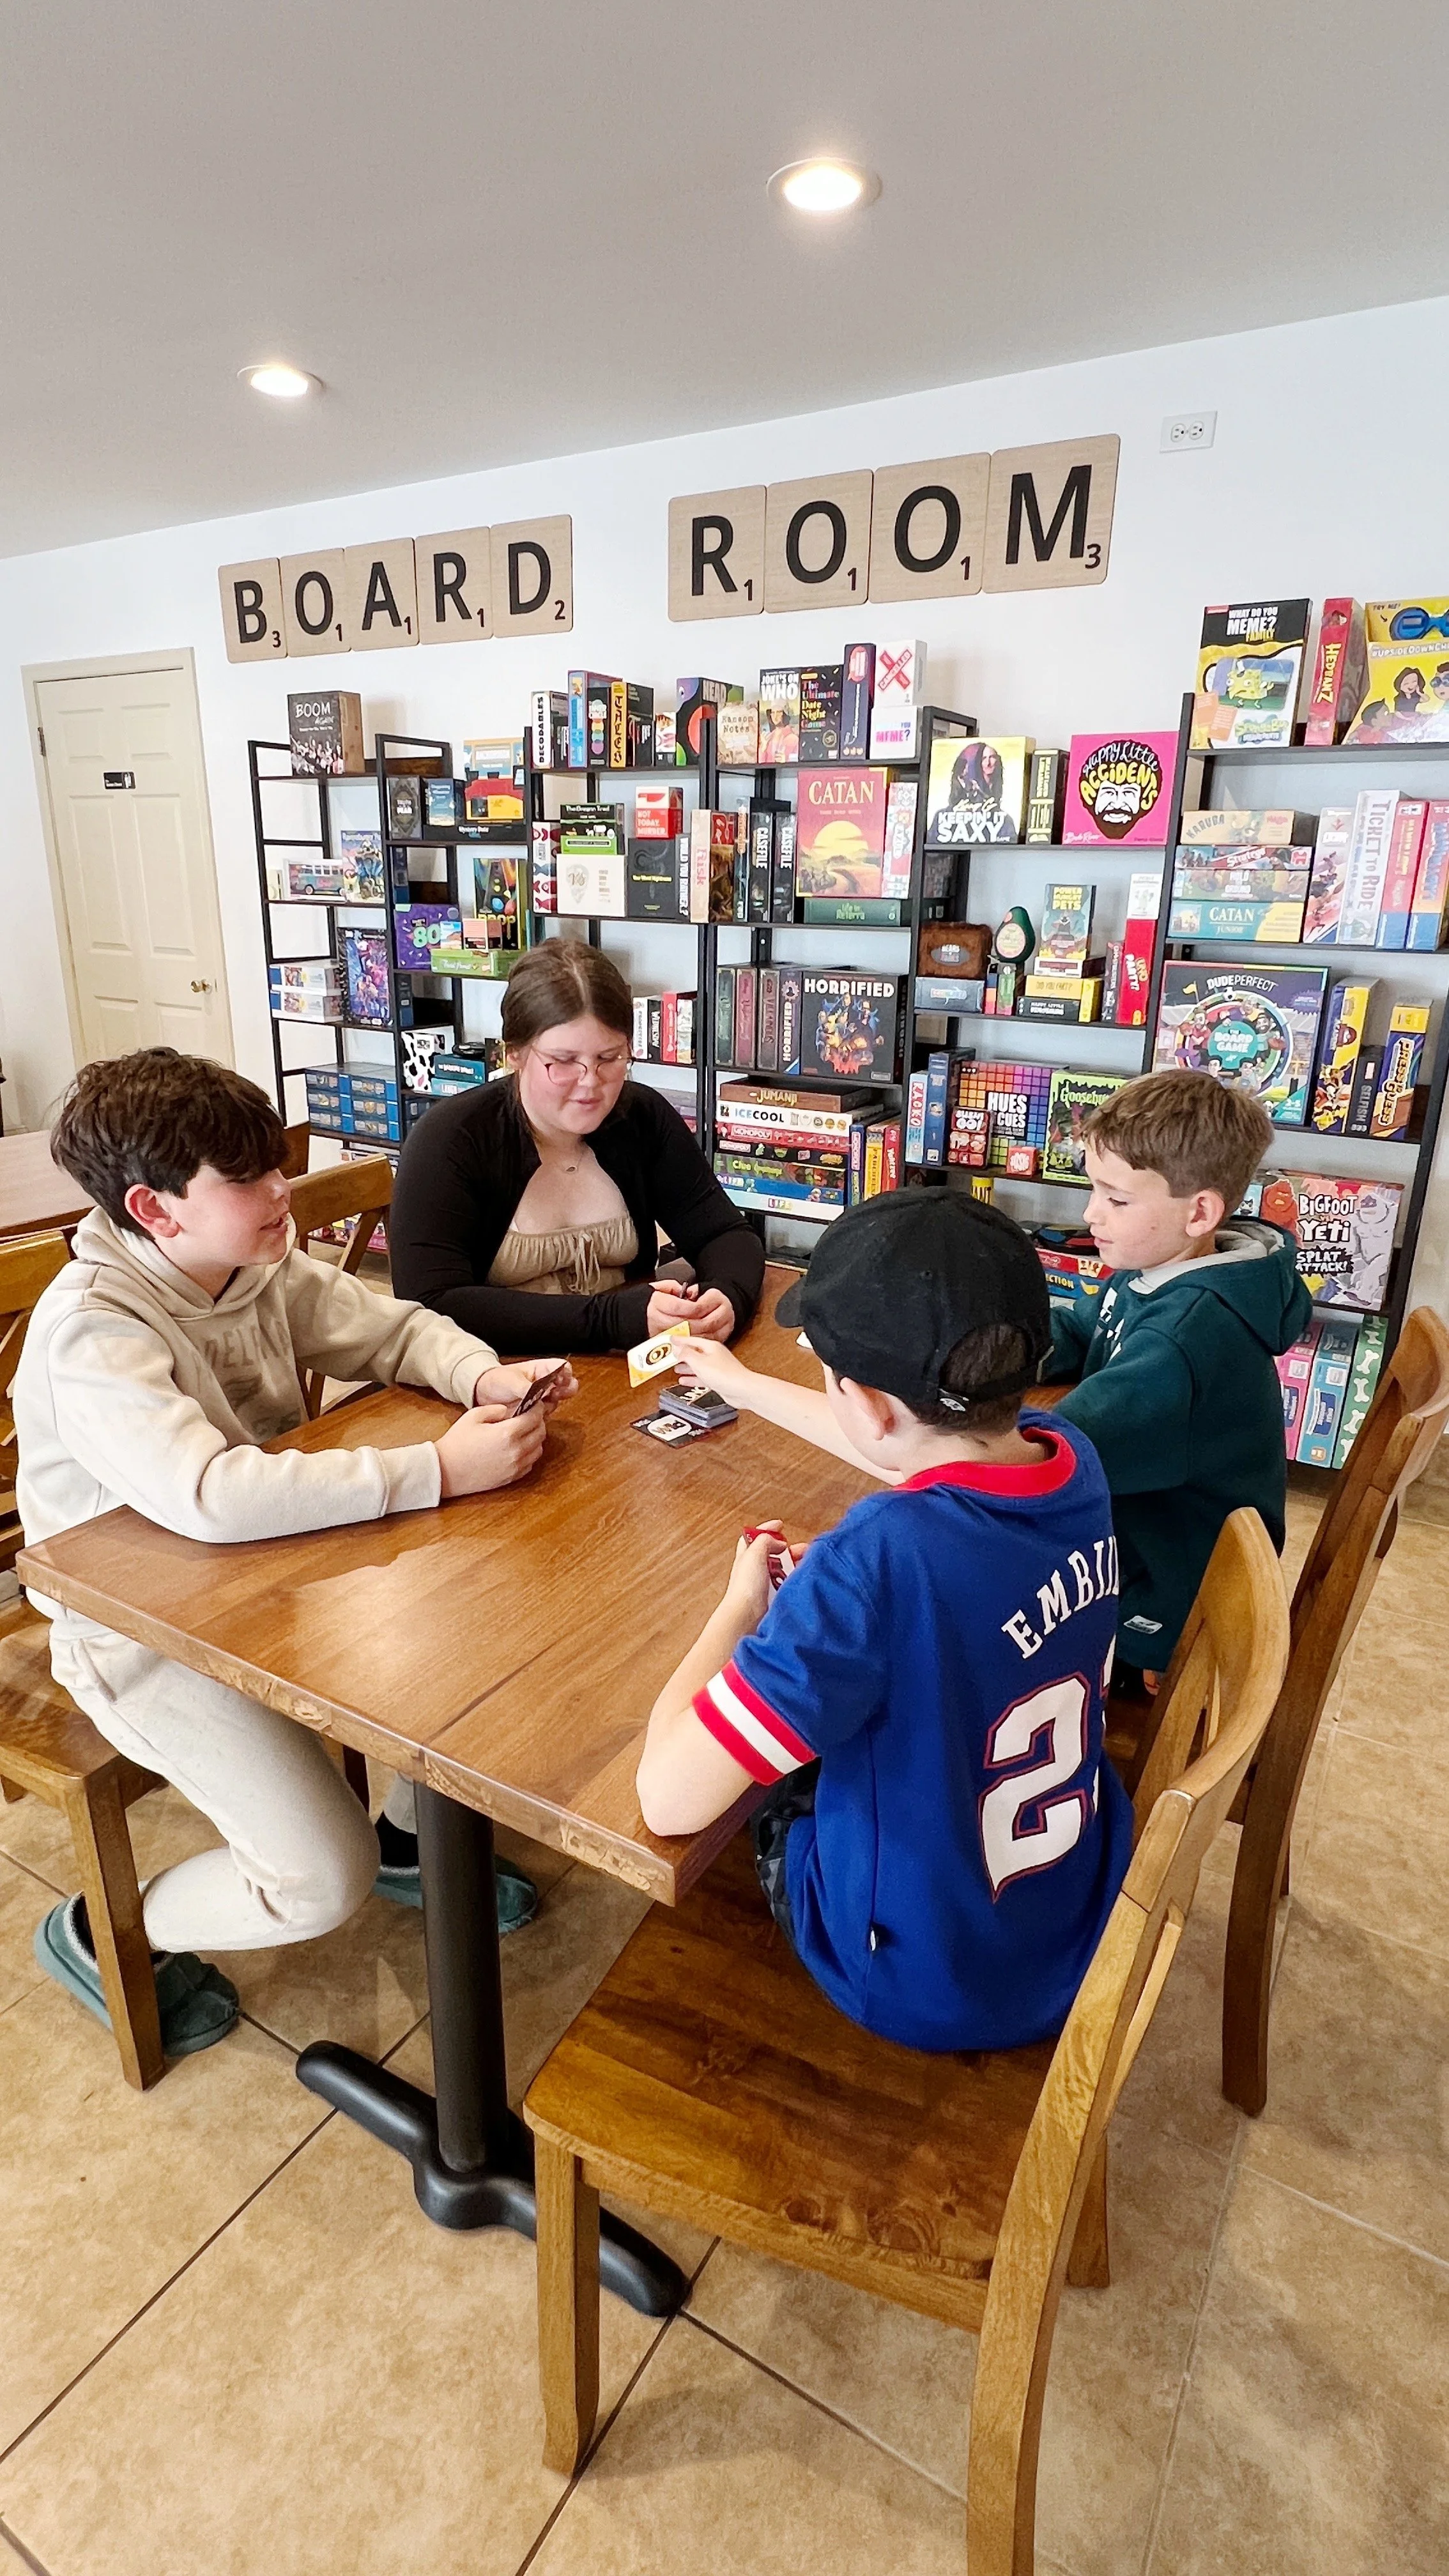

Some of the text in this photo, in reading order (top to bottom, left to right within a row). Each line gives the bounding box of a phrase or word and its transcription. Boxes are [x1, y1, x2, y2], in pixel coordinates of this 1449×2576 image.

[1229, 606, 1278, 619] WHAT DO YOU
[1226, 617, 1277, 636] MEME?
[1246, 629, 1275, 642] FAMILY
[762, 673, 786, 686] JOKE'S
[788, 673, 799, 684] ON
[761, 684, 799, 702] WHO
[295, 702, 331, 717] BOOM
[876, 729, 911, 744] MEME?
[1082, 741, 1159, 778] Happy Little
[808, 781, 875, 805] CATAN
[993, 811, 1008, 824] IT
[937, 822, 1004, 843] SAXY
[1365, 799, 1392, 856] TICKET
[696, 848, 707, 886] Risk
[1358, 875, 1381, 911] RIDE
[1052, 900, 1082, 910] PETS
[1209, 906, 1256, 923] CATAN
[804, 977, 895, 998] HORRIFIED
[782, 1001, 792, 1062] HORRIFIED
[1213, 1031, 1254, 1045] BOARD
[1216, 1041, 1250, 1053] GAME
[987, 1092, 1027, 1114] HUES
[1059, 1080, 1110, 1109] Goosebu
[1355, 1085, 1373, 1123] SELFISH
[997, 1112, 1027, 1128] CUES
[734, 1127, 771, 1139] MONOPOLY
[1298, 1193, 1359, 1216] BIGFOOT
[1296, 1250, 1342, 1264] SPLAT
[1294, 1260, 1349, 1273] ATTACK!
[978, 1652, 1112, 1904] 2
